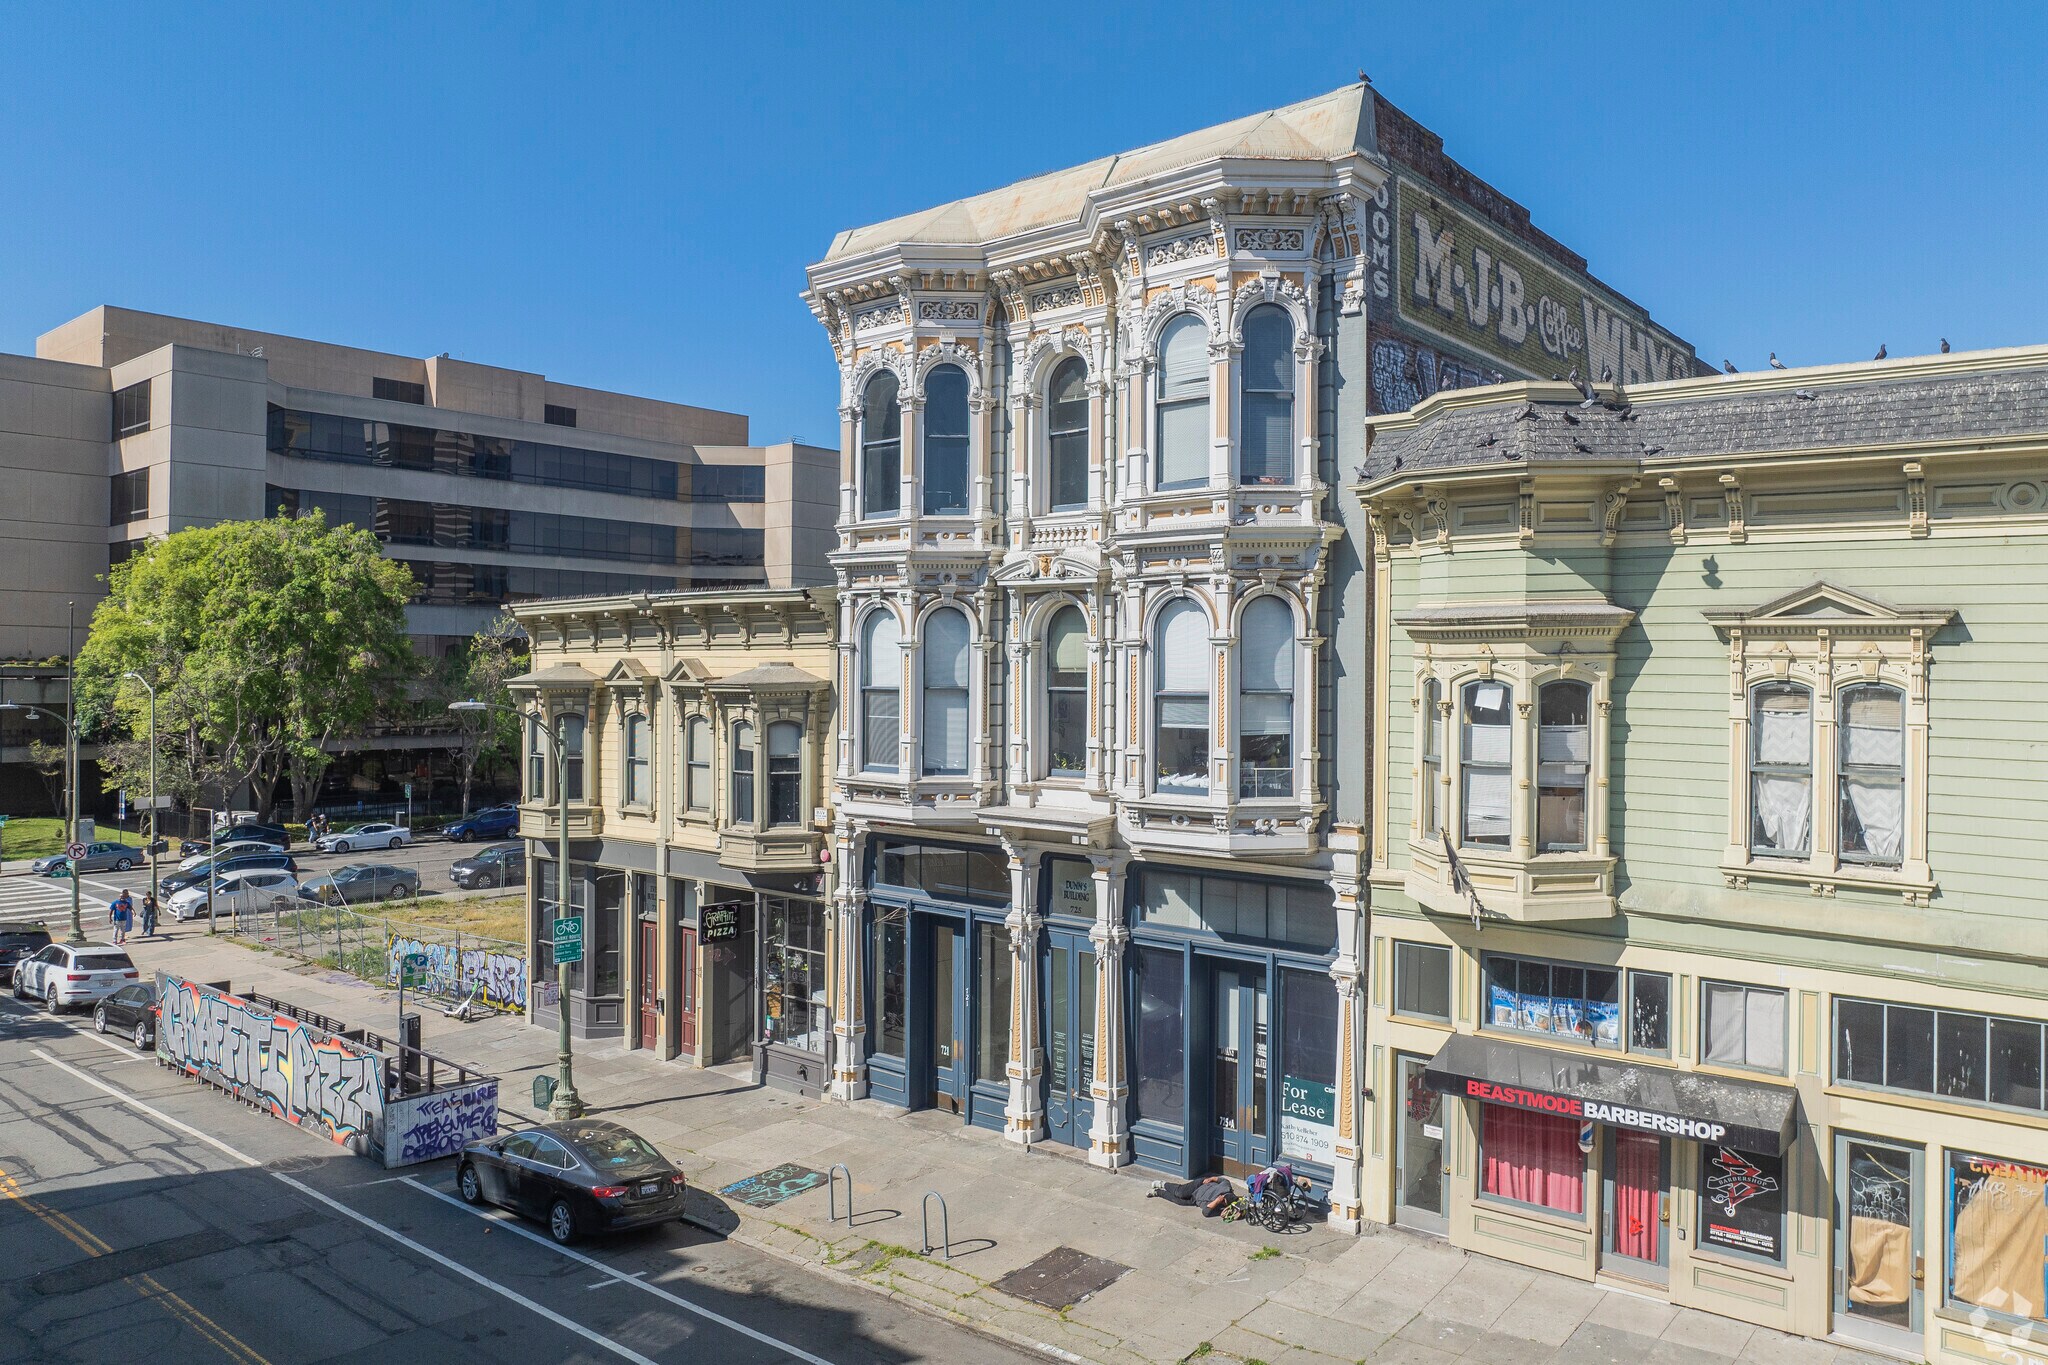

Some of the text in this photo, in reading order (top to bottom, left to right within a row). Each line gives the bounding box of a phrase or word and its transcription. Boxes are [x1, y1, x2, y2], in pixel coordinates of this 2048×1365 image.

[1372, 154, 1390, 298] OOMS
[1539, 295, 1583, 359] Coffee
[1063, 890, 1090, 902] BUILDING
[708, 926, 734, 938] PIZZA
[941, 1045, 950, 1056] 721
[291, 1025, 385, 1145] PIZZA
[1282, 1082, 1308, 1100] For
[1282, 1097, 1325, 1119] Lease
[1467, 1080, 1725, 1141] BEASTMODE BARBERSHOP
[1281, 1131, 1295, 1140] 510
[1295, 1134, 1309, 1144] 874
[1310, 1137, 1329, 1149] 1909
[1718, 1176, 1767, 1187] BARBERSHOP
[1740, 1230, 1773, 1241] BARBERSHOP
